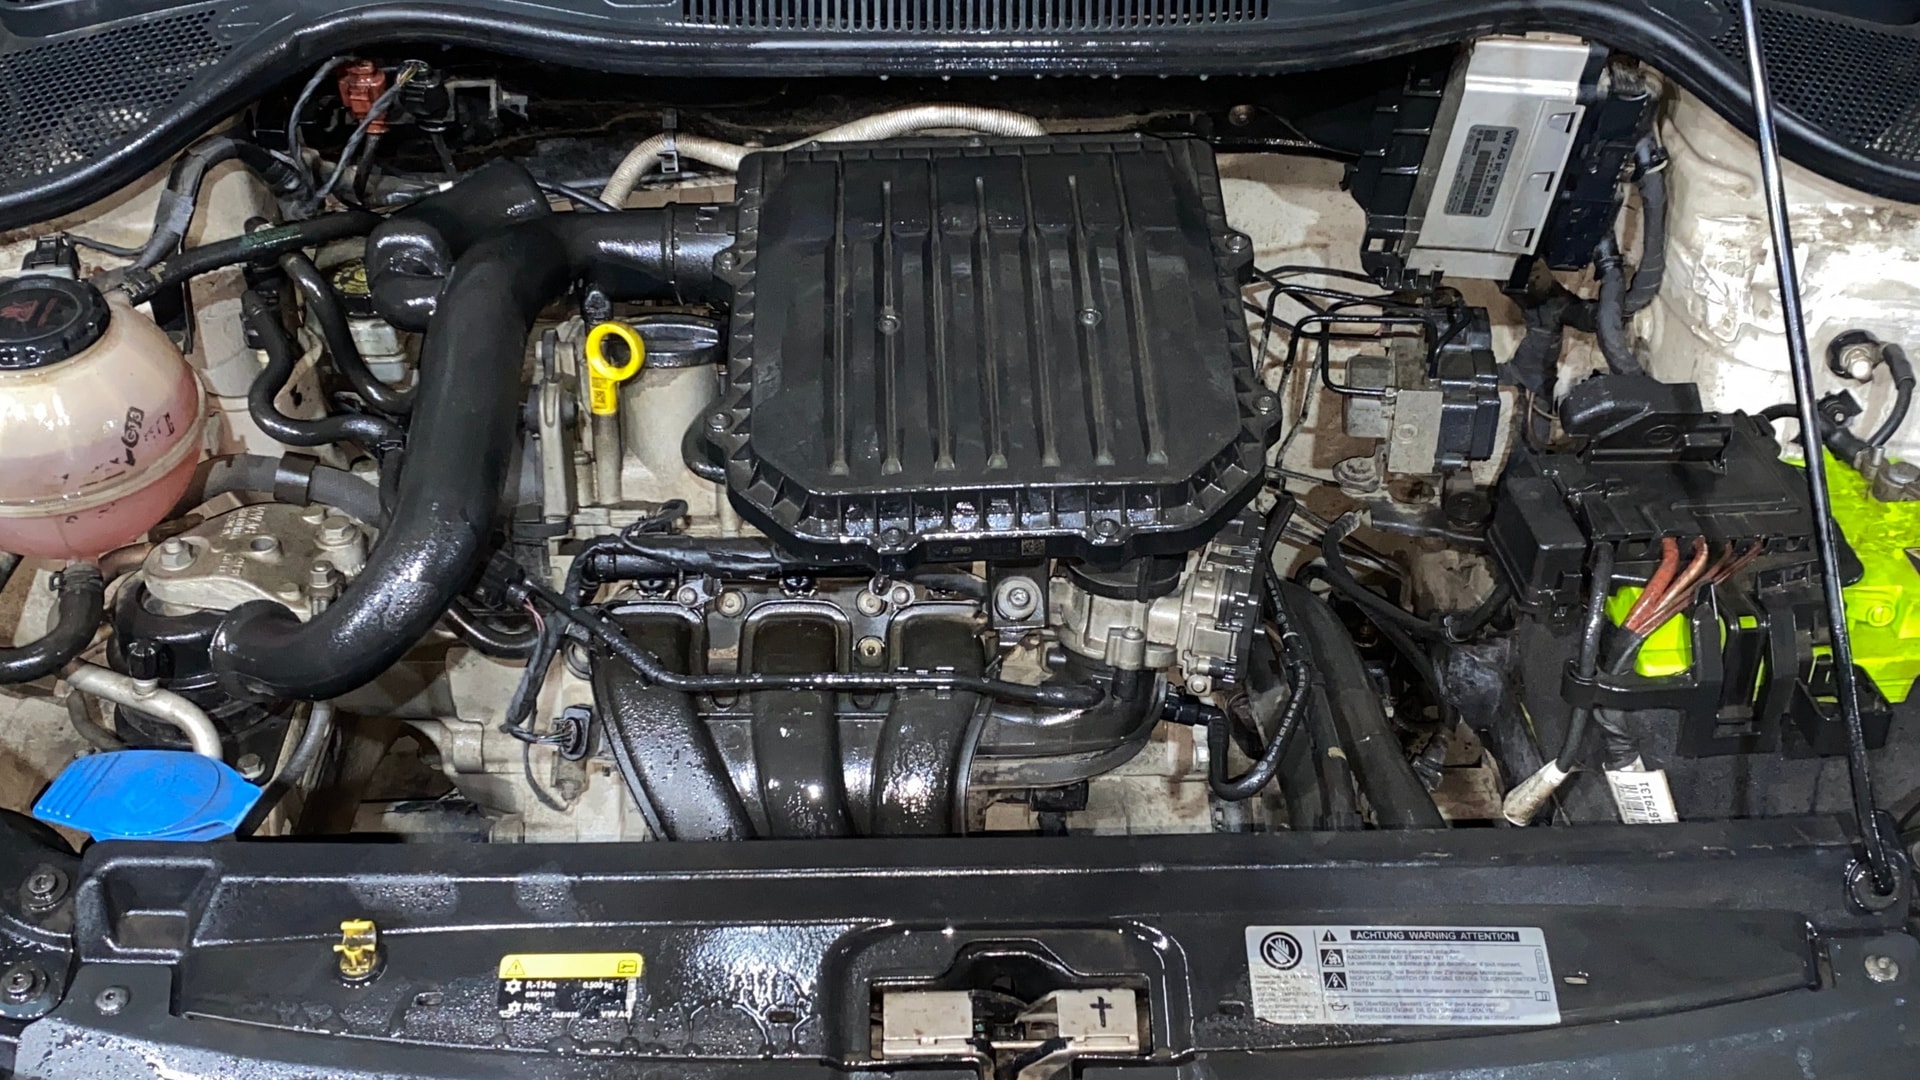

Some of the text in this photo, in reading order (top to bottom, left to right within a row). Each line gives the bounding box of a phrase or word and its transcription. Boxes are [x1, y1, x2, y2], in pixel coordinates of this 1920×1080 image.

[1356, 931, 1515, 941] ACHTUNG WARNING ATTENTION
[526, 981, 557, 989] R-134a
[523, 1003, 541, 1011] PAG
[601, 1010, 617, 1018] VW
